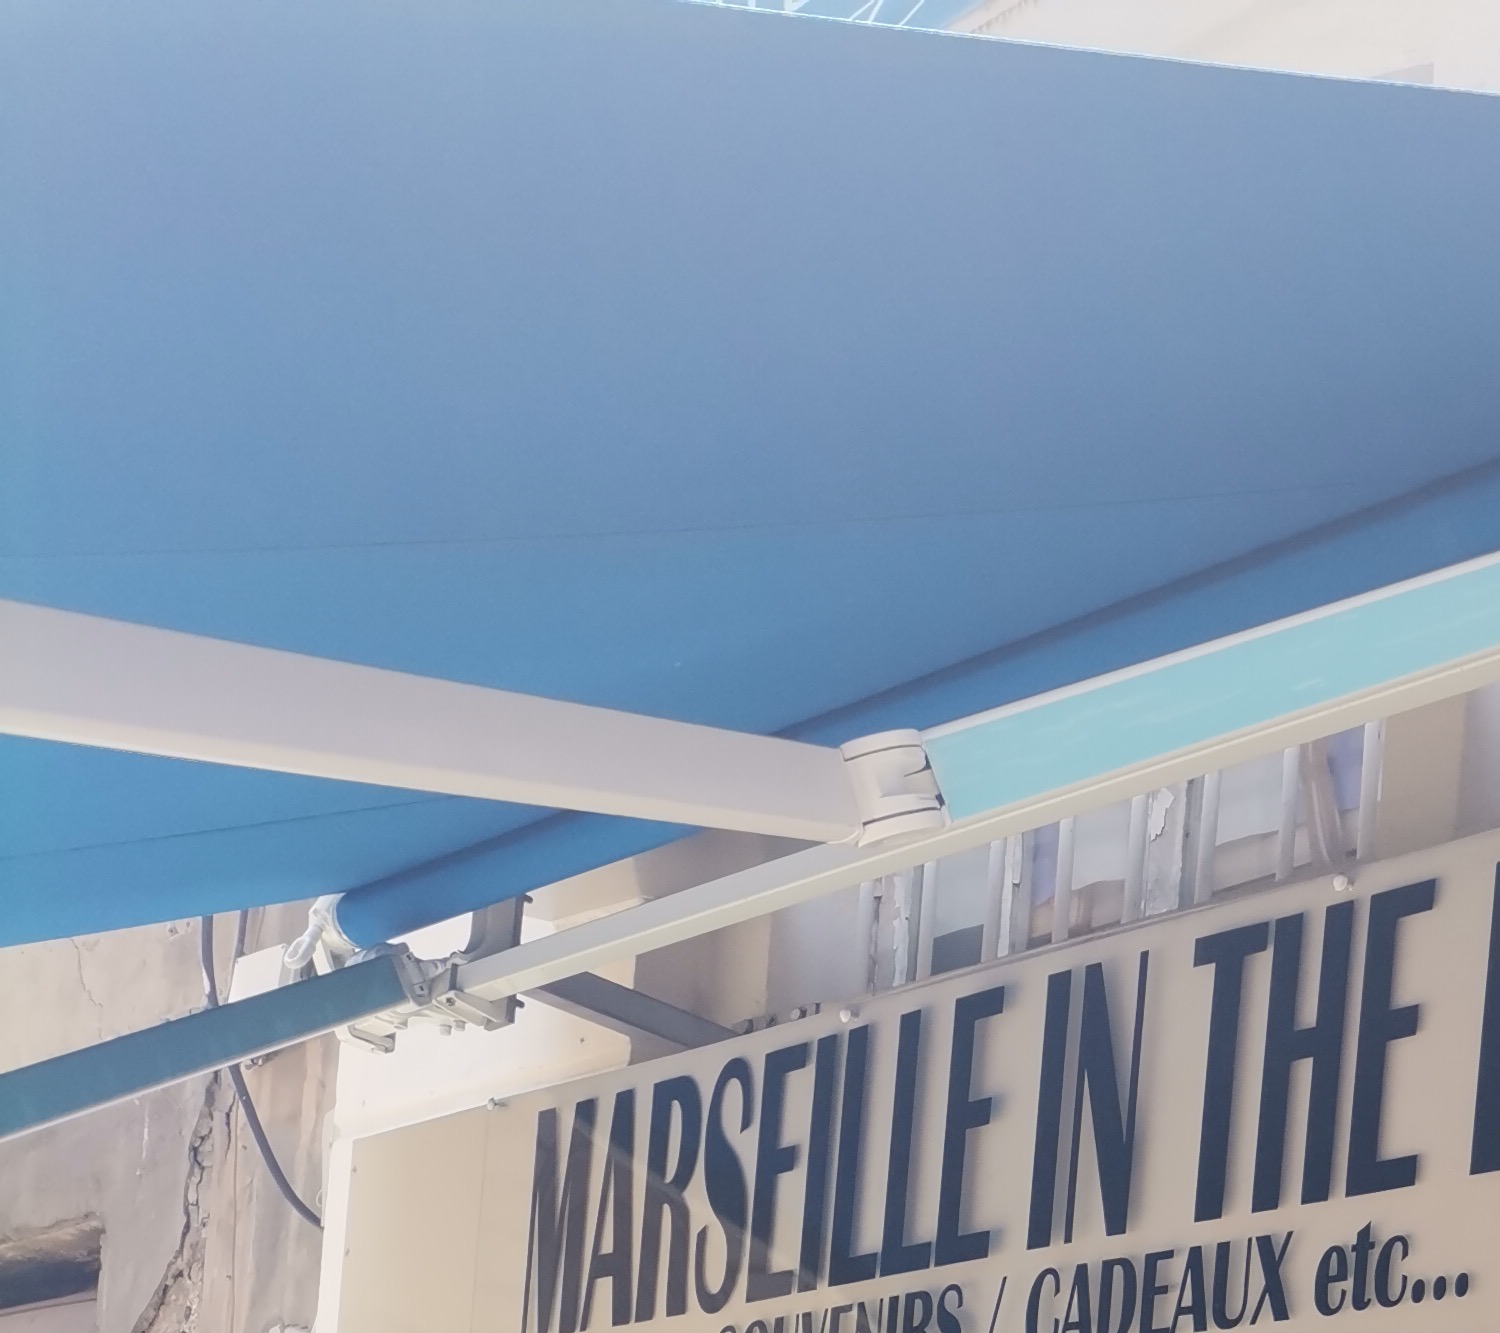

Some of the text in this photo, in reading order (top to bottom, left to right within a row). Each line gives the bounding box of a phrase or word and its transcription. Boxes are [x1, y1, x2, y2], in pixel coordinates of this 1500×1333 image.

[1025, 950, 1150, 1252] IN
[1194, 879, 1440, 1222] THE
[1314, 1229, 1472, 1319] etc...
